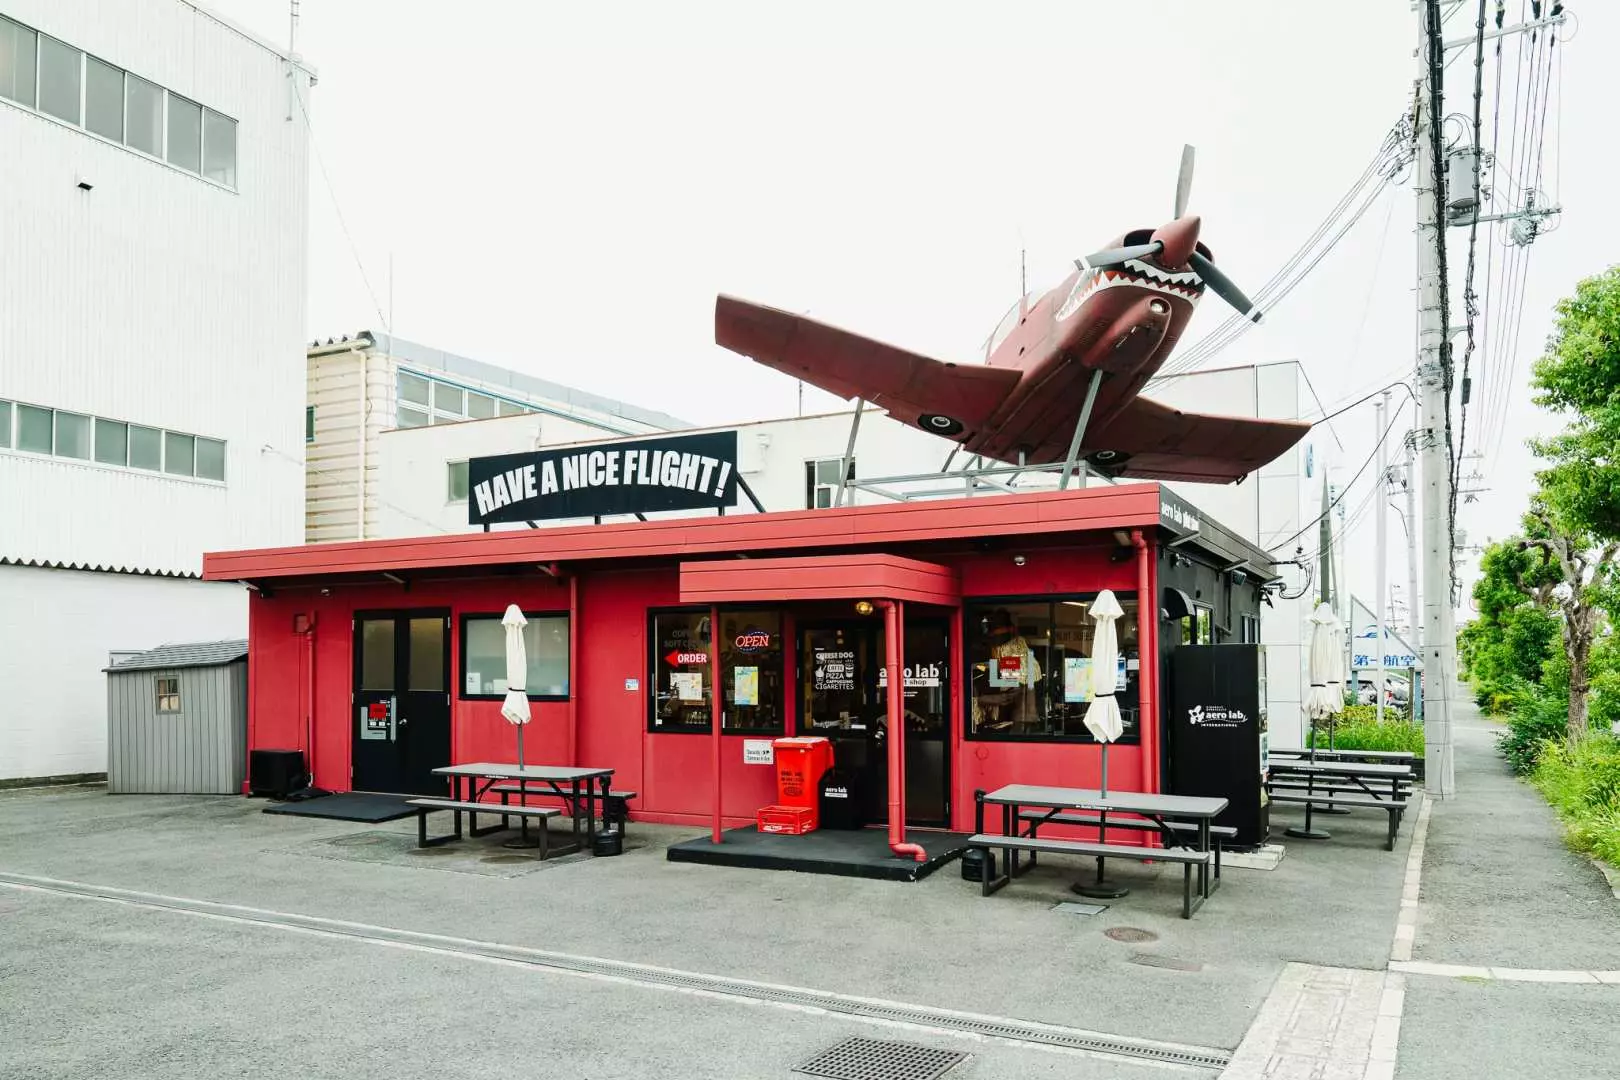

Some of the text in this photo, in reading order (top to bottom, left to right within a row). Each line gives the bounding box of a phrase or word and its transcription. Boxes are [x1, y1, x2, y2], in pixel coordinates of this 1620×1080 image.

[473, 450, 732, 516] HAVE A NICE FLIGHT!
[735, 635, 770, 647] OPEN
[677, 653, 708, 663] ORDER
[838, 651, 854, 659] DOG
[1354, 655, 1416, 666] 第一航空
[879, 663, 940, 678] ao lab
[825, 672, 845, 680] PIZZA
[1228, 710, 1244, 719] lab
